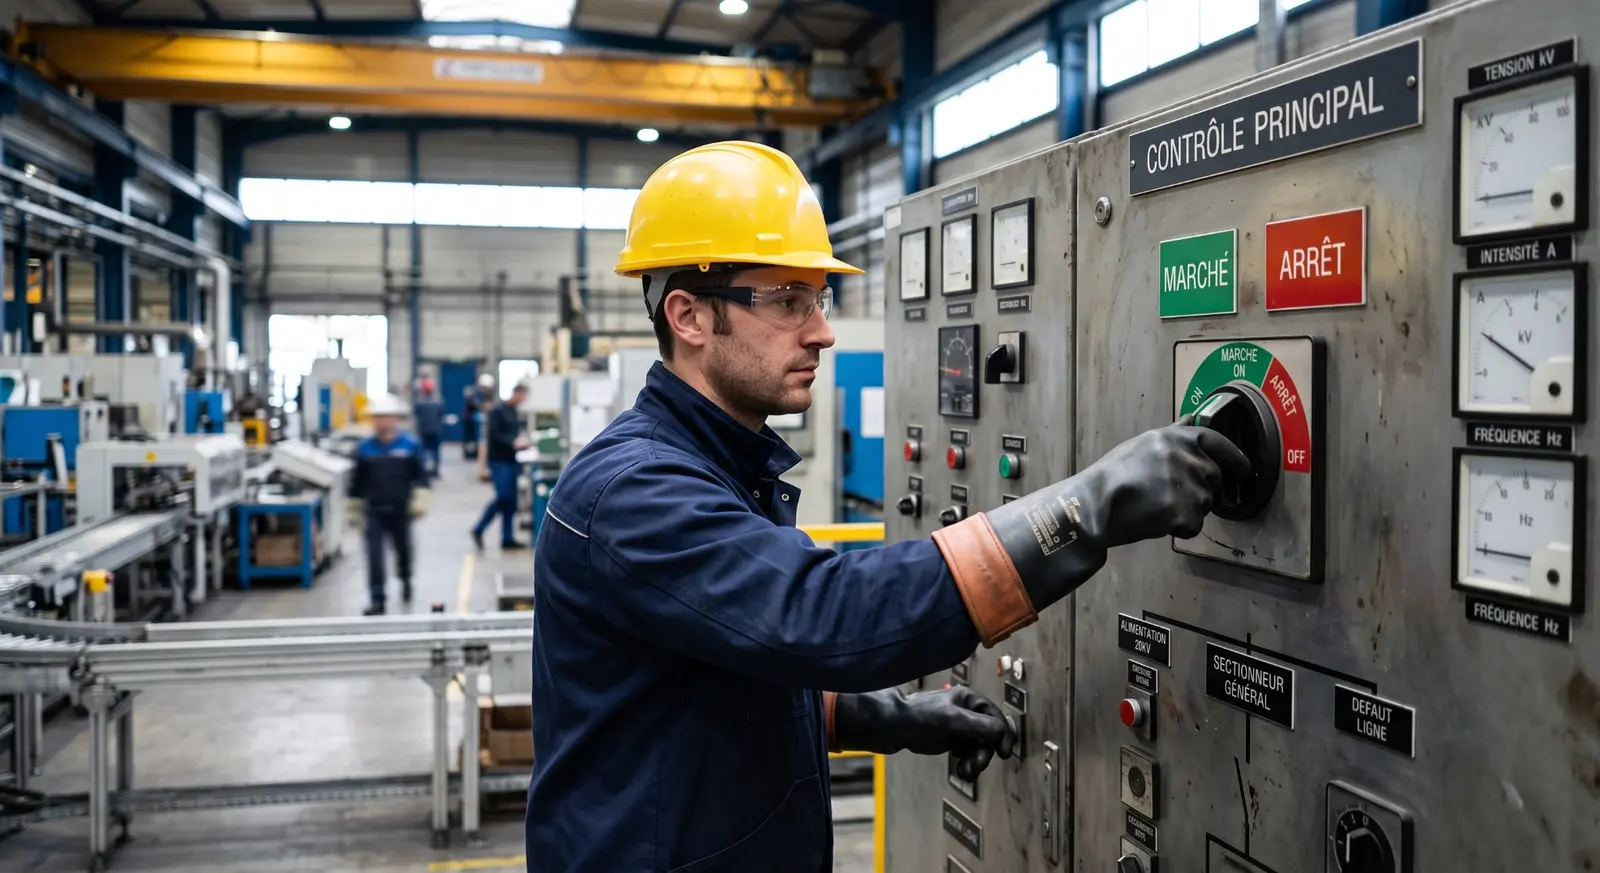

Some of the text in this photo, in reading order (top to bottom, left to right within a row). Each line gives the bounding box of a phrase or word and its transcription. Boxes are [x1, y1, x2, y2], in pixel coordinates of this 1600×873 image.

[1484, 48, 1555, 81] TENSION kV
[1147, 76, 1385, 174] CONTRÔLE PRINCIPAL
[1279, 236, 1346, 281] ARRÊT
[1480, 240, 1556, 264] INTENSITÉ A
[1164, 251, 1229, 292] MARCHÉ
[1476, 291, 1486, 305] A
[1221, 348, 1258, 362] MARCHE
[1233, 364, 1246, 377] ON
[1190, 386, 1204, 406] ON
[1269, 374, 1297, 417] ARRÊT
[1474, 424, 1562, 446] FRÉQUENCE Hz
[1287, 449, 1306, 465] OFF
[1474, 602, 1560, 635] FRÉQUENCE Hz
[1121, 620, 1167, 645] ALIMENTATION
[1213, 655, 1284, 693] SECTIONNEUR
[1225, 679, 1271, 711] GÉNÉRAL
[1352, 697, 1393, 723] DEFAUT
[1357, 718, 1387, 741] LIGNE
